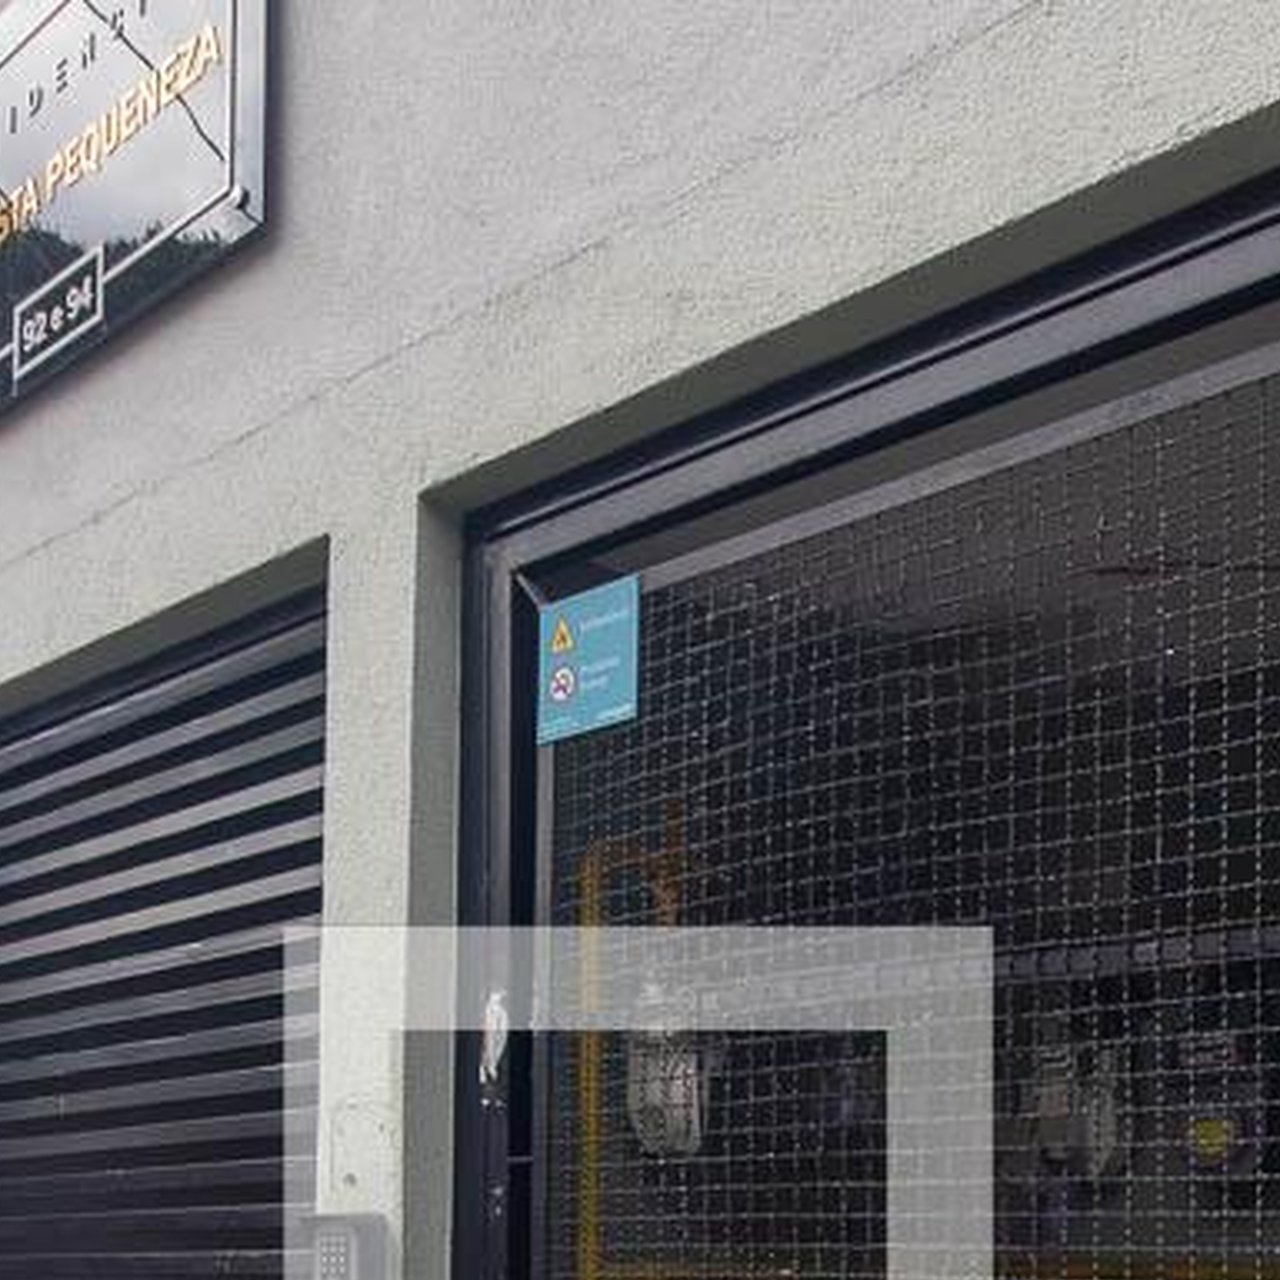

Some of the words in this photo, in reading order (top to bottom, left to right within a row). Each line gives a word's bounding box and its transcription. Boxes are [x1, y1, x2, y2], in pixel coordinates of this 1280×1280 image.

[38, 24, 221, 201] PEQUENEZA
[23, 311, 48, 352] 92
[50, 306, 64, 331] e
[66, 275, 93, 320] 94
